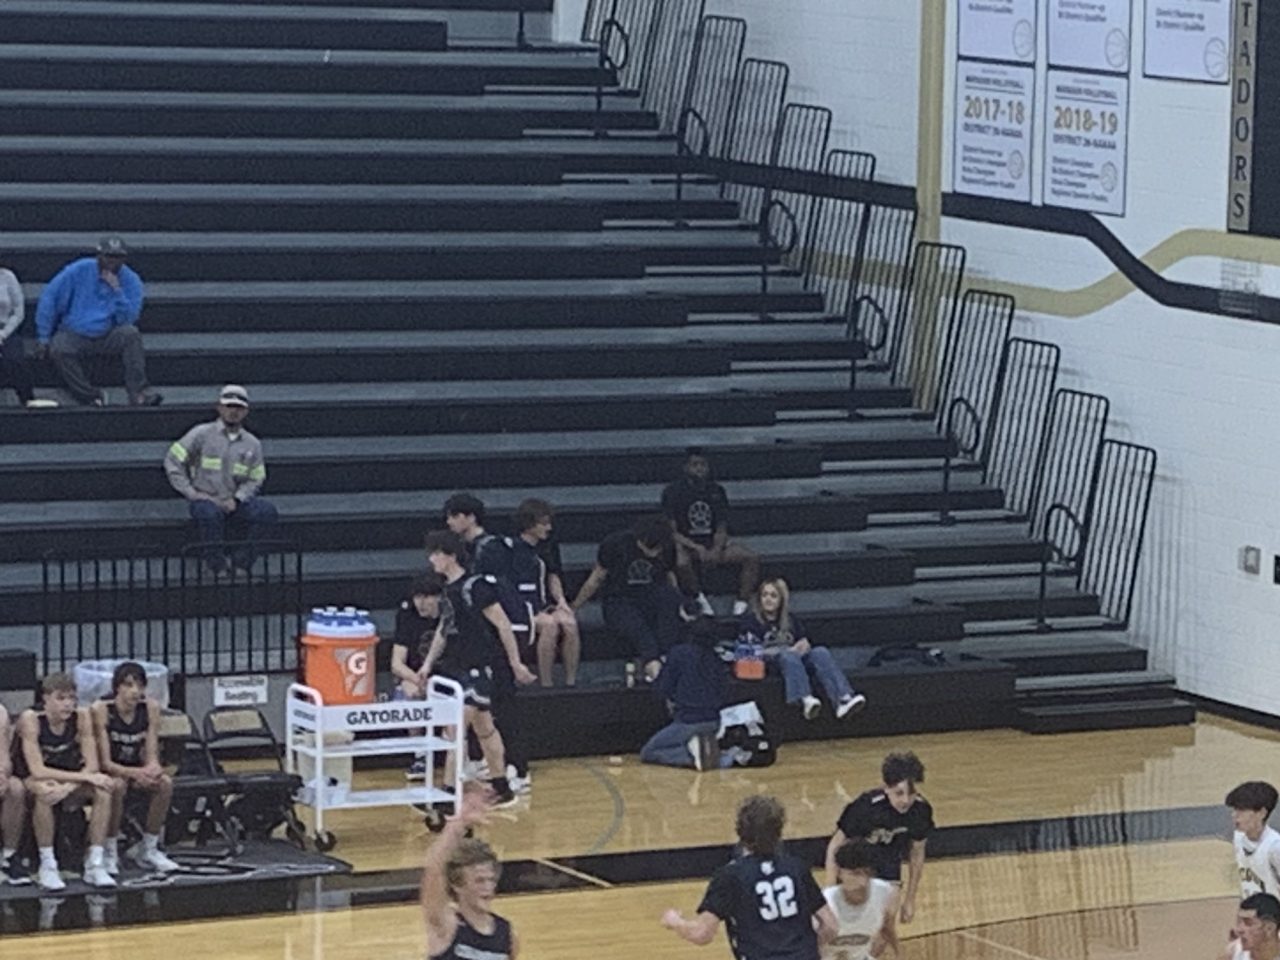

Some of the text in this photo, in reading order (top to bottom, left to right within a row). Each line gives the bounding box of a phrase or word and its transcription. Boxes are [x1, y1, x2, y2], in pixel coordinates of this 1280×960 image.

[964, 95, 1026, 125] 2017-18
[1054, 105, 1118, 136] 2018-19
[348, 651, 368, 675] G
[346, 707, 433, 725] GATORADE
[755, 875, 798, 921] 32
